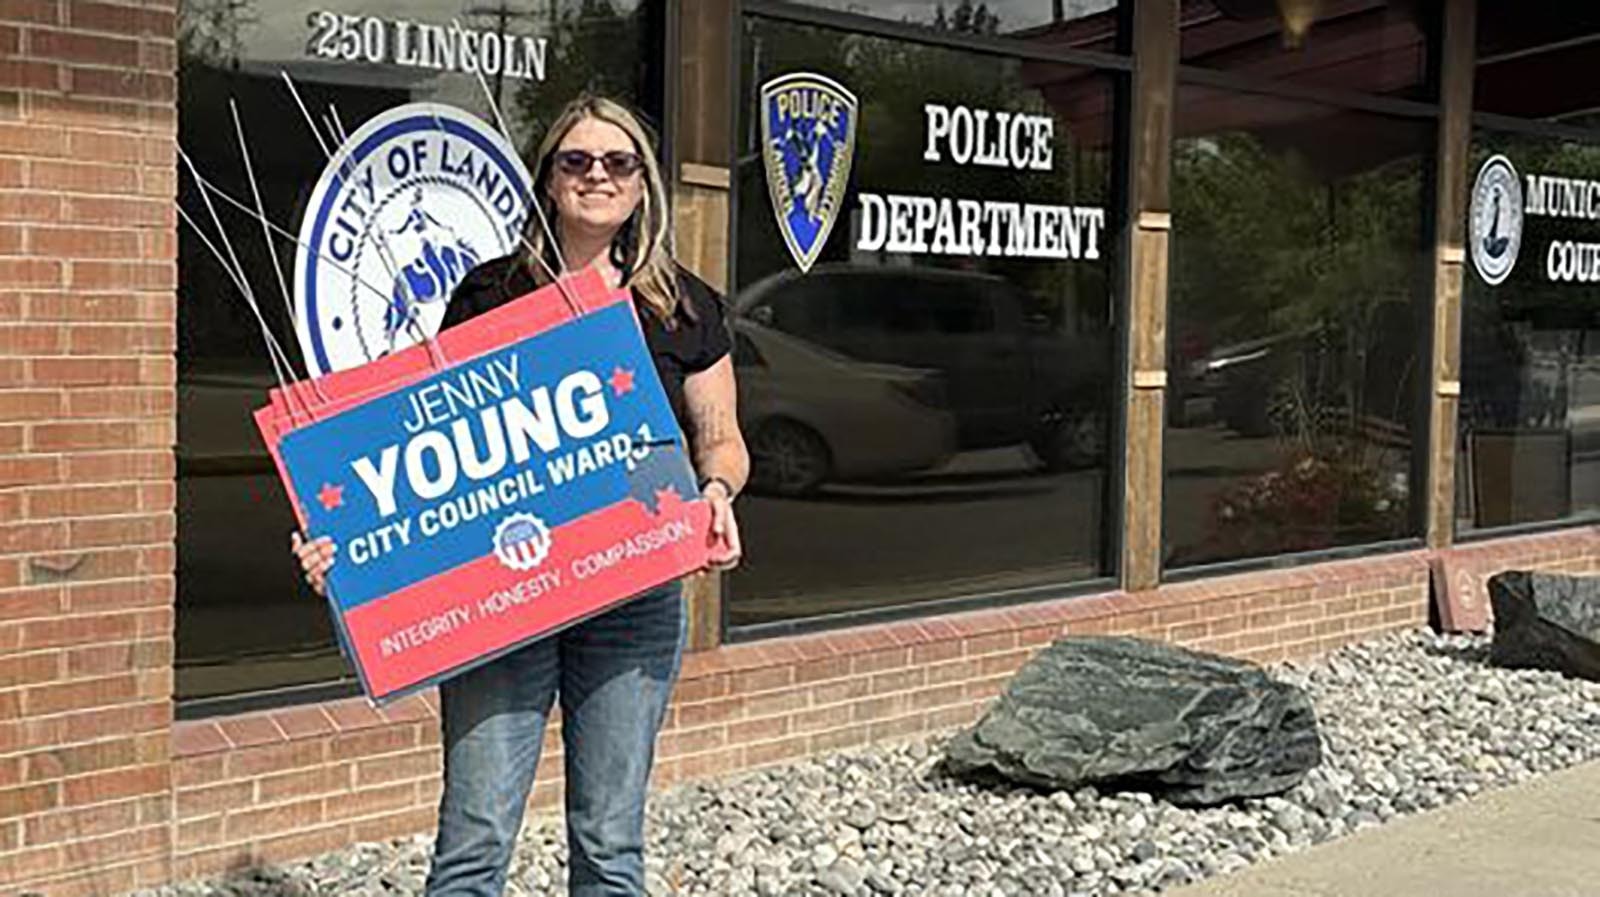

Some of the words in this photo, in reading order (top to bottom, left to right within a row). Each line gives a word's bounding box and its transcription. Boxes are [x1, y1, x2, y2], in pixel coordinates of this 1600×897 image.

[316, 11, 384, 63] 250
[395, 20, 548, 81] LINCOLN
[777, 90, 841, 128] POLICE
[924, 103, 1054, 170] POLICE
[328, 166, 376, 263] CITY
[388, 139, 428, 179] OF
[857, 193, 1105, 259] DEPARTMENT
[403, 354, 521, 433] JENNY
[351, 370, 610, 517] YOUNG
[349, 518, 413, 564] CITY
[418, 473, 545, 537] COUNCIL
[546, 433, 632, 486] WARD
